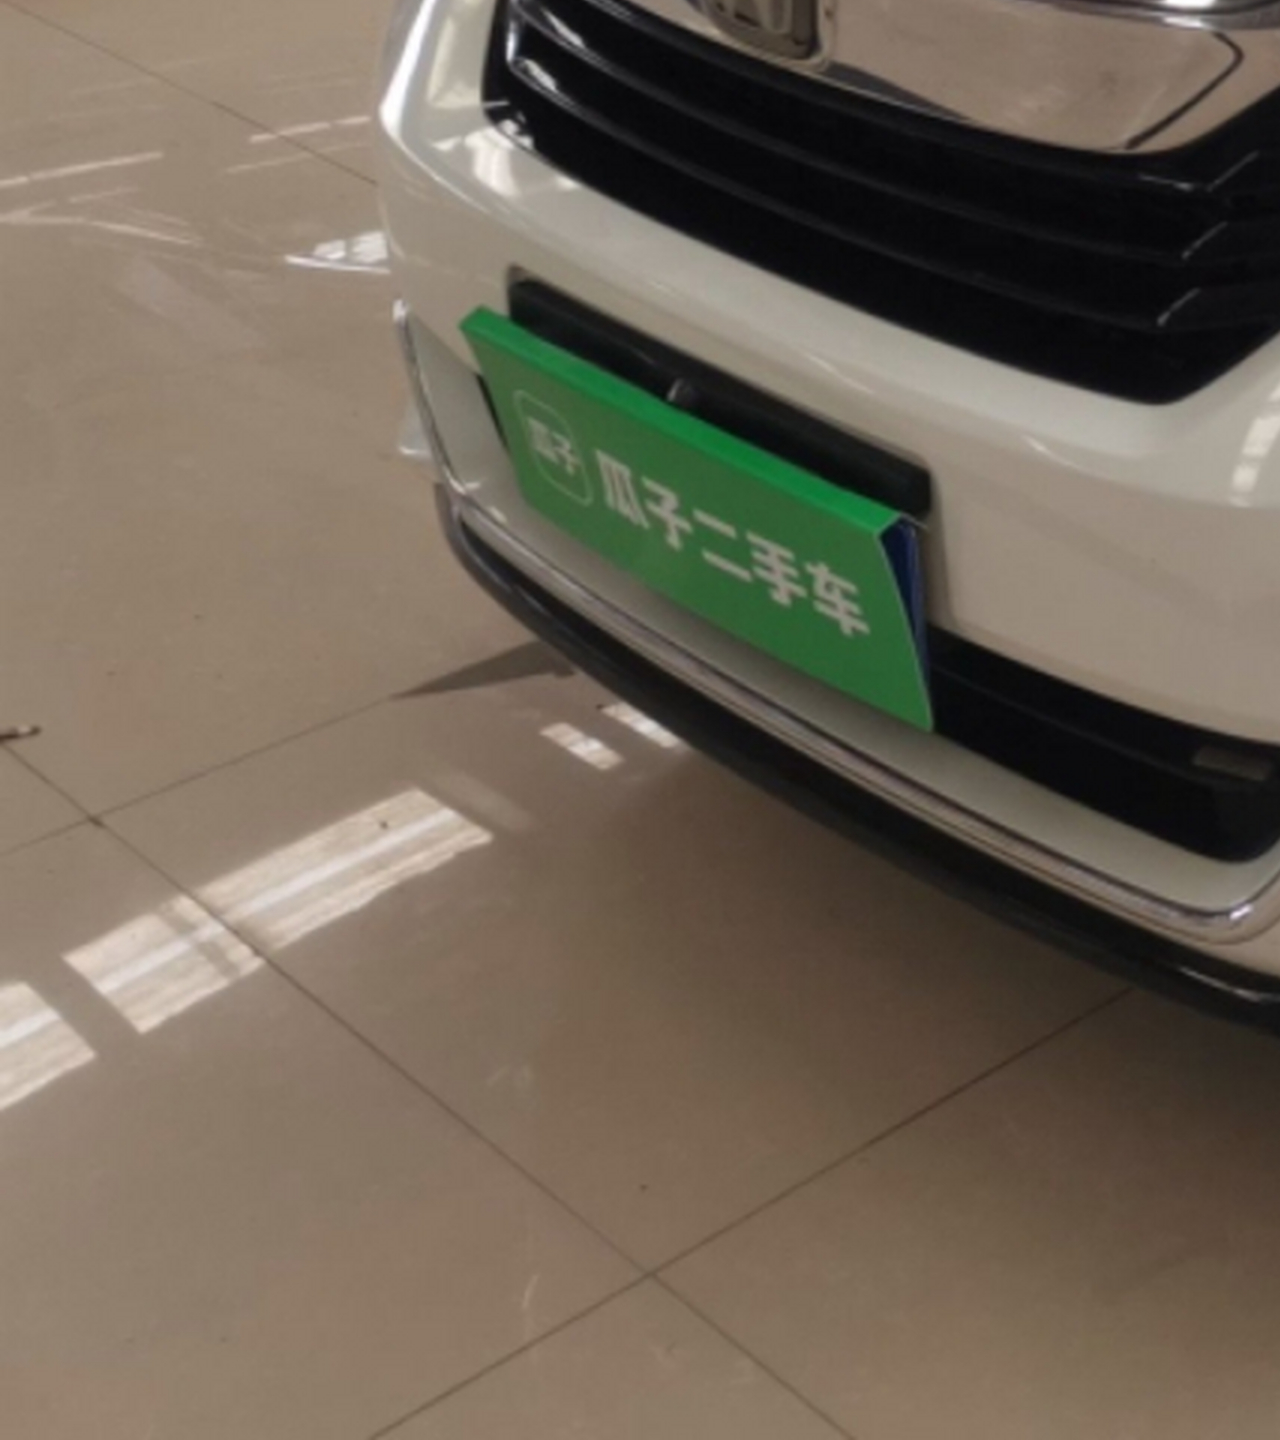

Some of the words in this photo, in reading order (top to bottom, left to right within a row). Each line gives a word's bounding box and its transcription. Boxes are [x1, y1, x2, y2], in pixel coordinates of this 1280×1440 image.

[595, 448, 872, 638] 瓜子二手车
